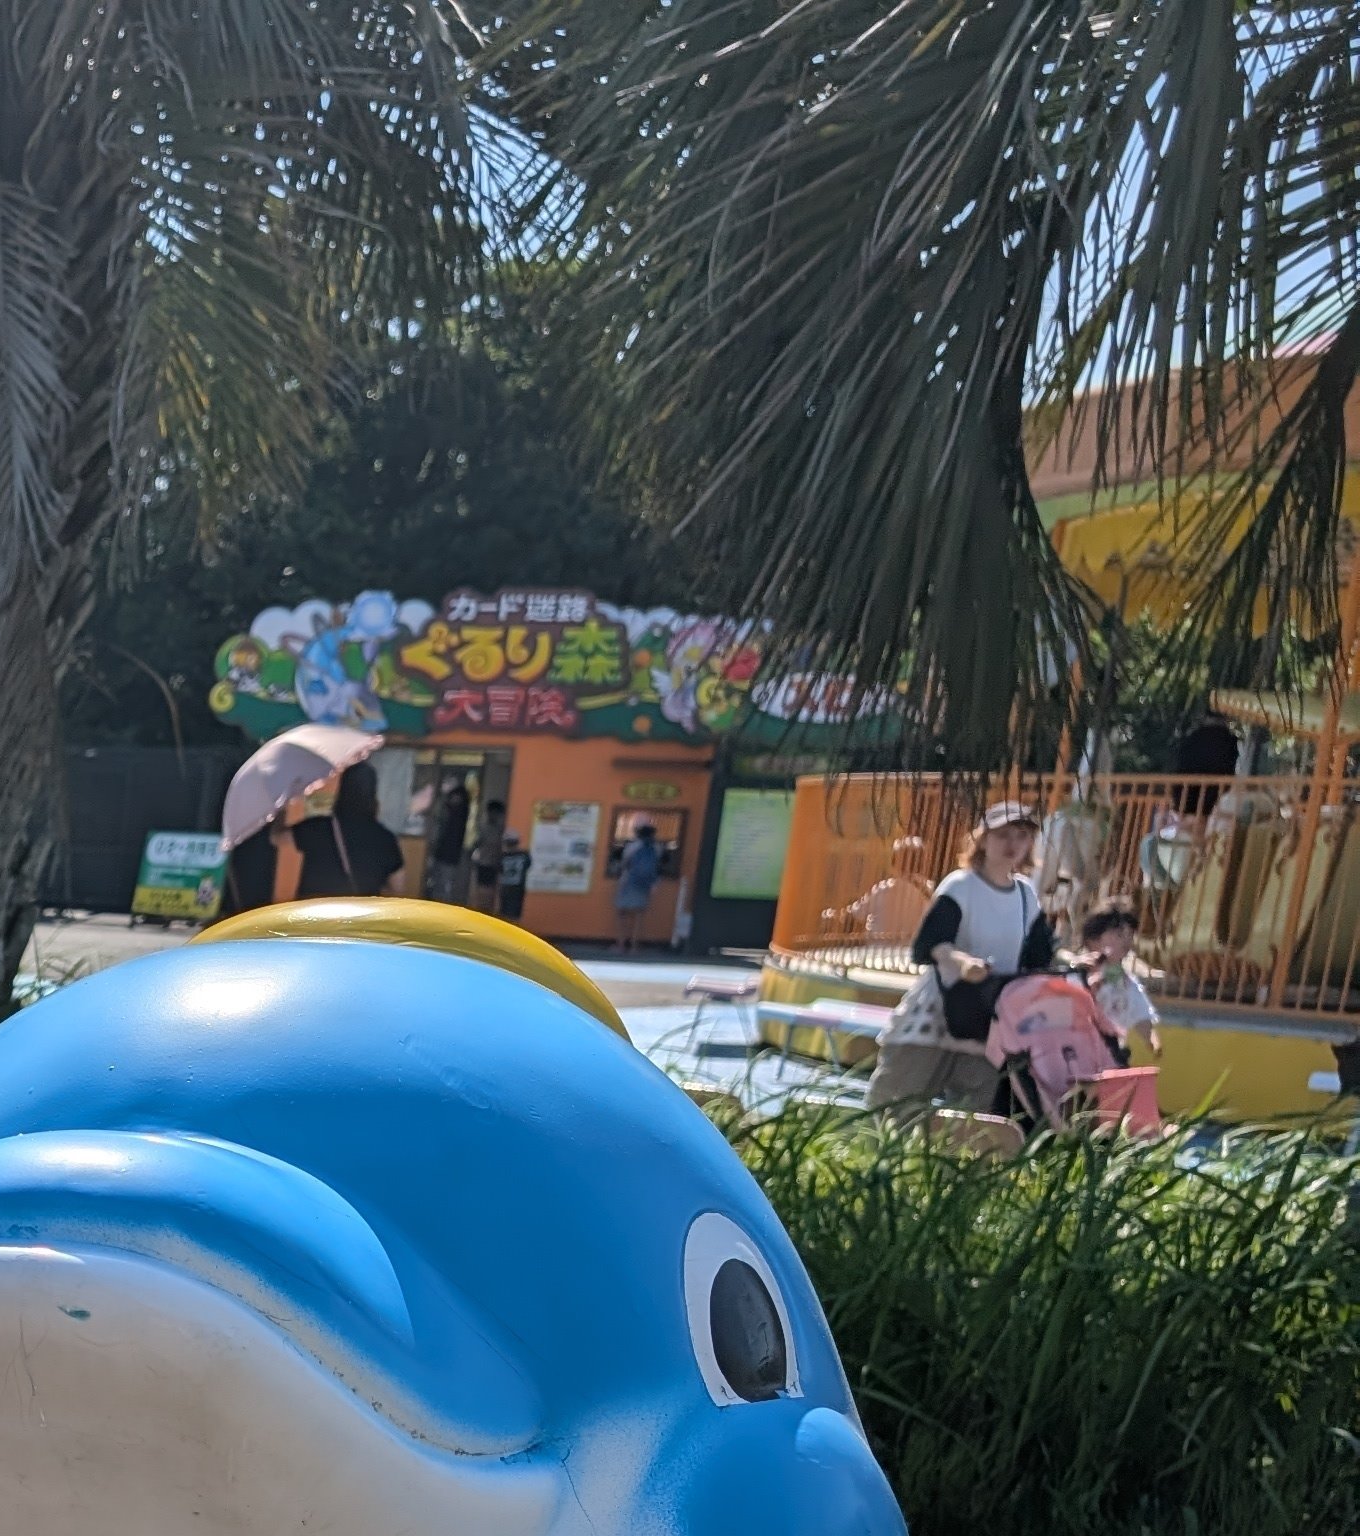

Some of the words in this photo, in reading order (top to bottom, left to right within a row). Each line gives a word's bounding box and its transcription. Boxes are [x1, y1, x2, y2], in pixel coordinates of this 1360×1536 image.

[446, 591, 588, 623] カード迷路
[401, 616, 622, 683] ぐるり森
[435, 686, 576, 727] 大冒険
